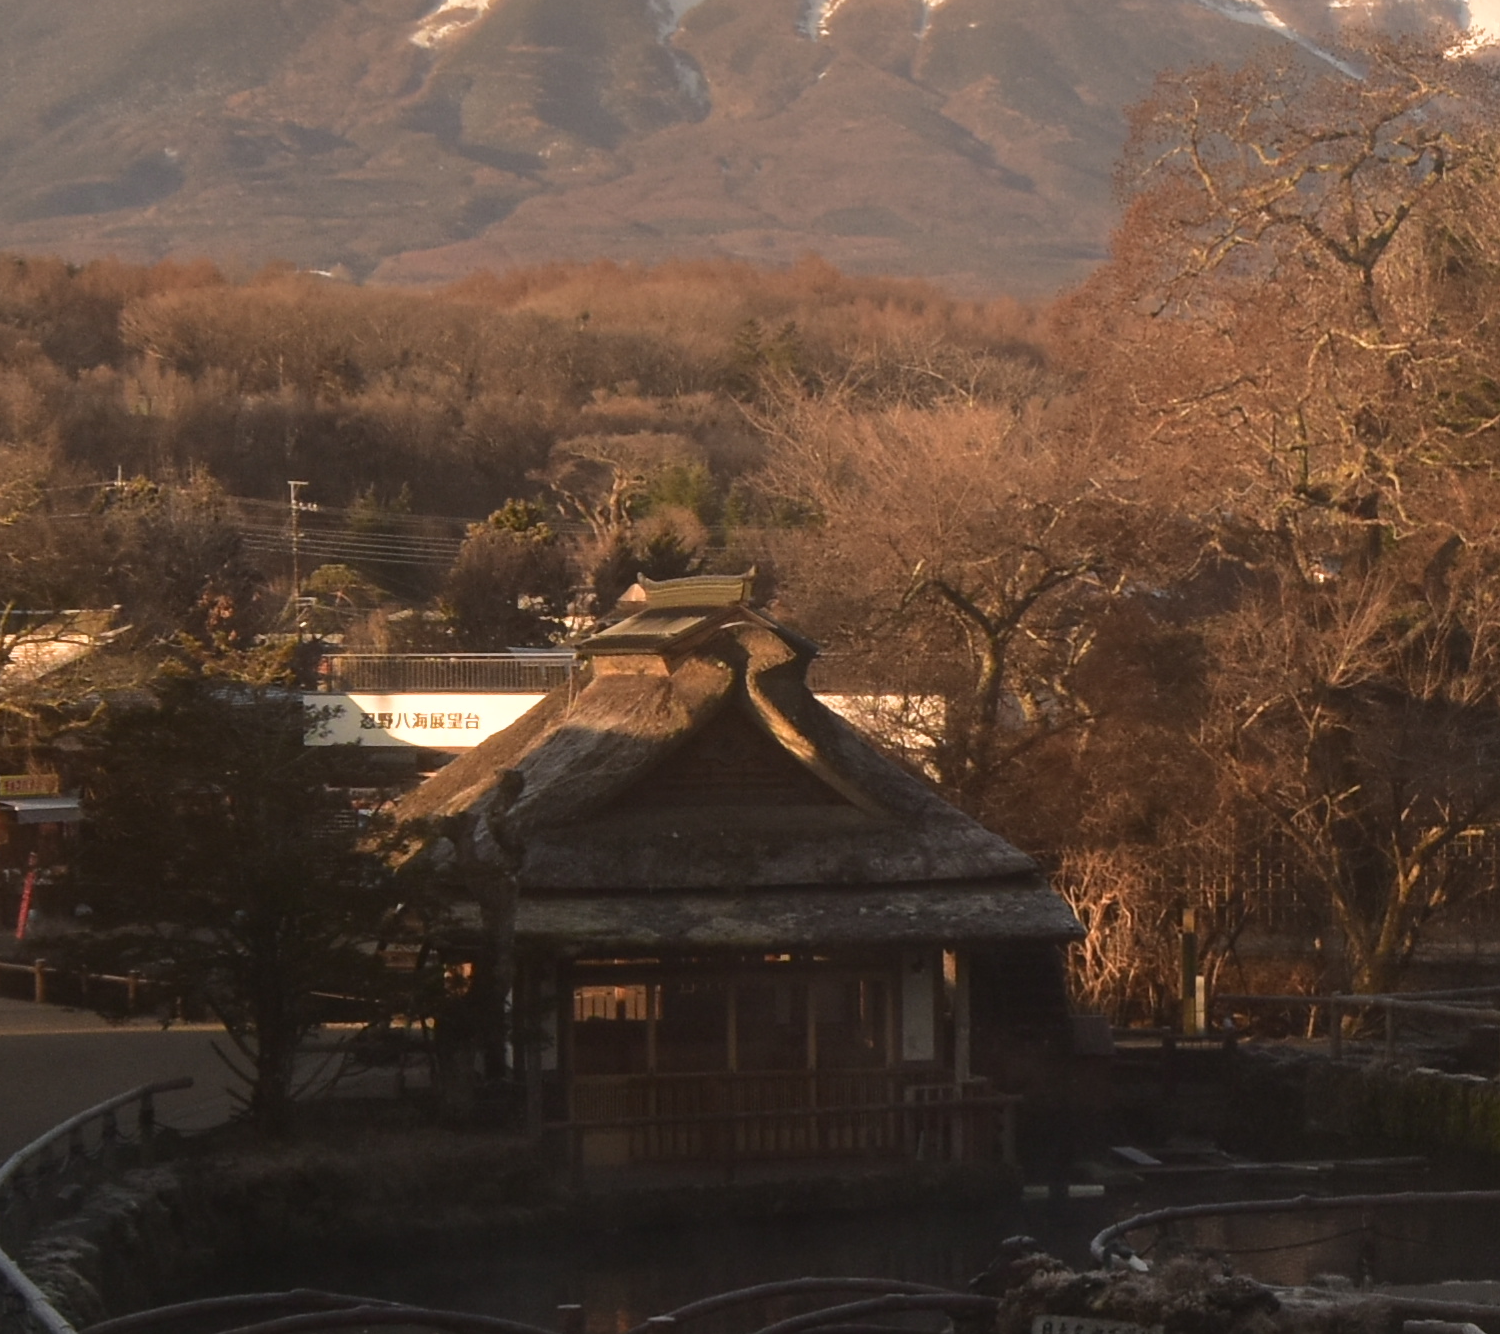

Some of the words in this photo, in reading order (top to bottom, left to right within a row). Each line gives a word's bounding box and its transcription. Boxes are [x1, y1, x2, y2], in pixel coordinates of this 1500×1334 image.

[360, 713, 480, 730] 忍野八海展望台
